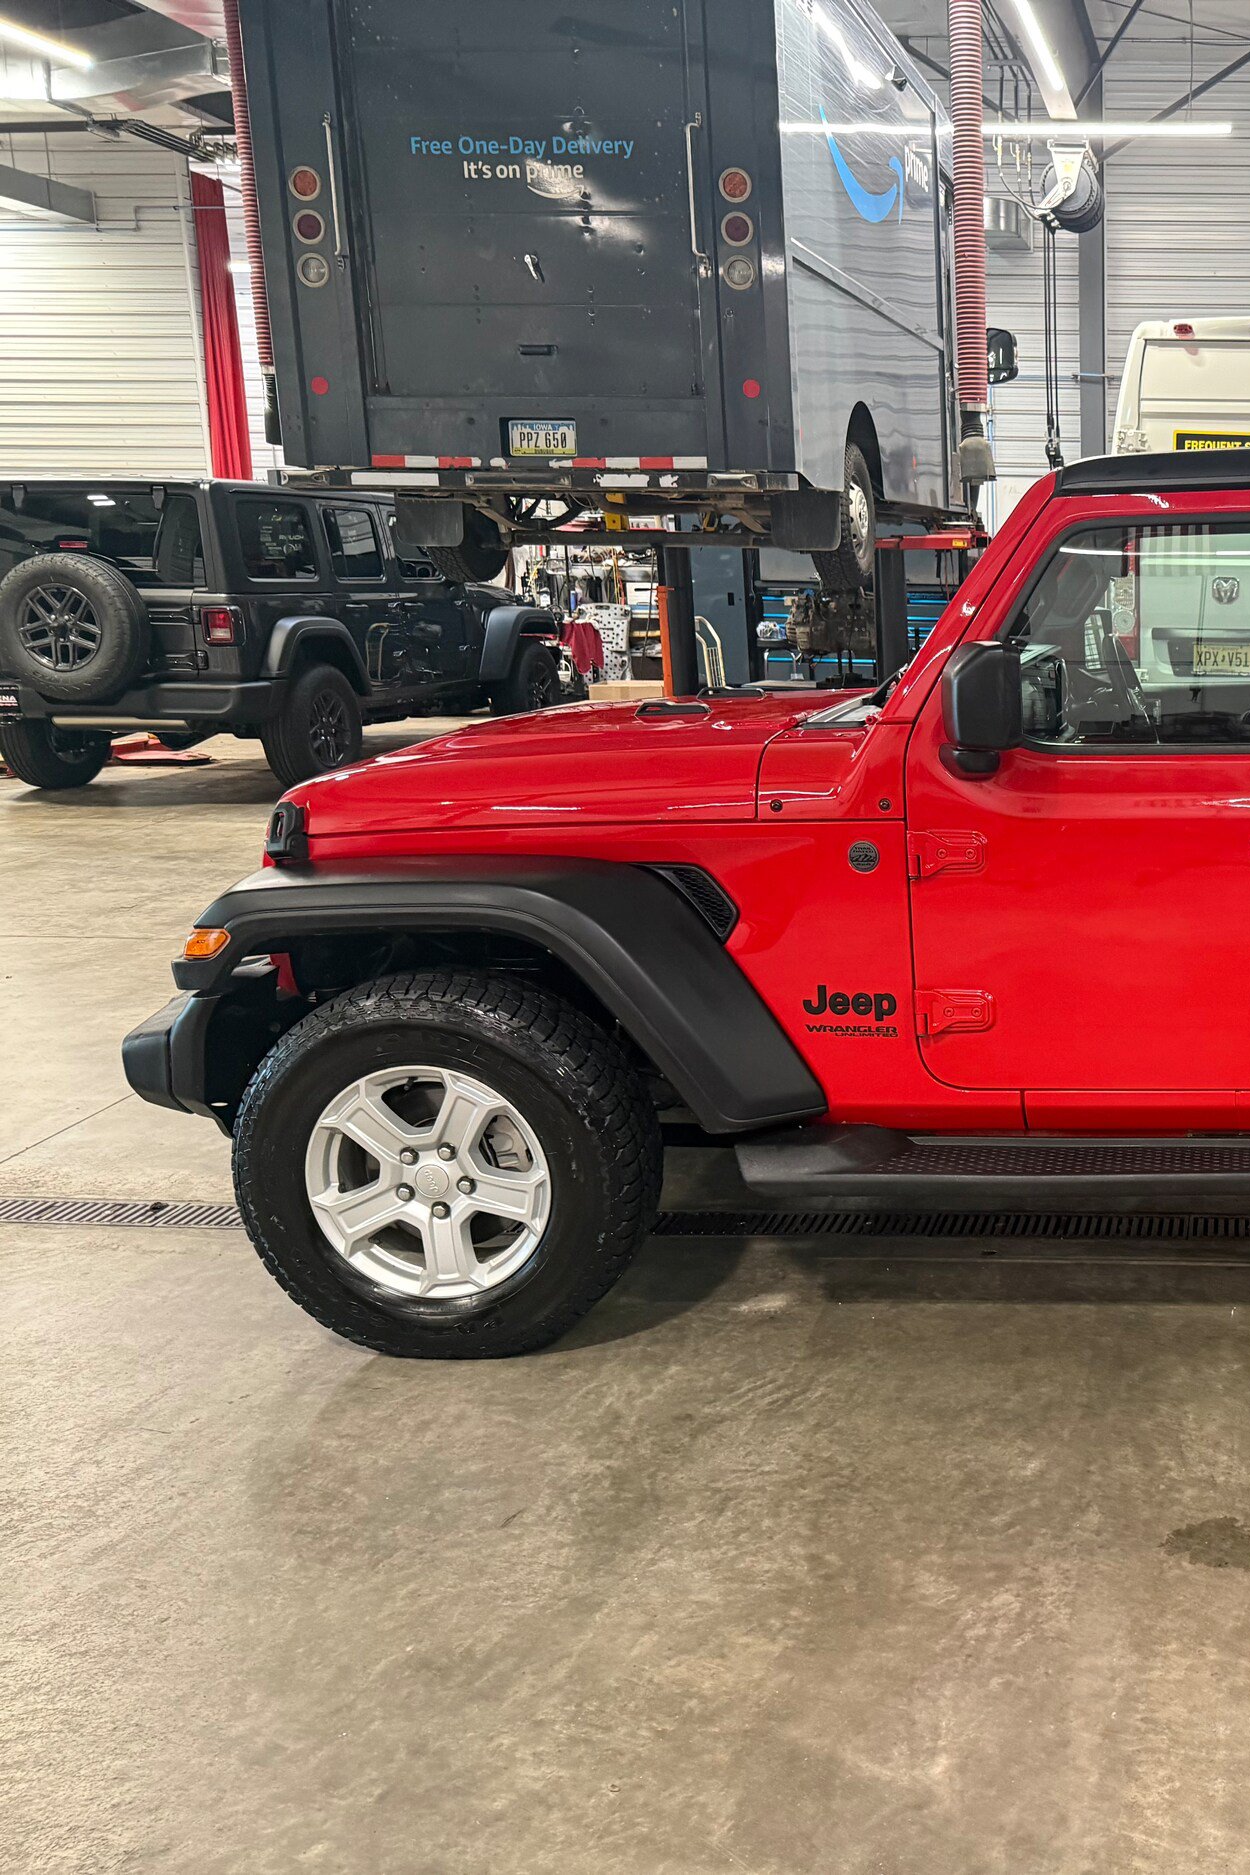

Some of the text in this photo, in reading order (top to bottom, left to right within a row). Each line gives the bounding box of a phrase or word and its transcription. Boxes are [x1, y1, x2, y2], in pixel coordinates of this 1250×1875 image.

[410, 136, 634, 159] Free One-Day Delivery
[463, 160, 584, 183] It's on prime
[904, 144, 929, 193] prime
[533, 423, 553, 431] IOWA
[519, 431, 567, 449] PPZ 650
[1196, 650, 1250, 668] XPX V51
[803, 984, 897, 1022] Jeep
[805, 1024, 898, 1033] WRANGLER
